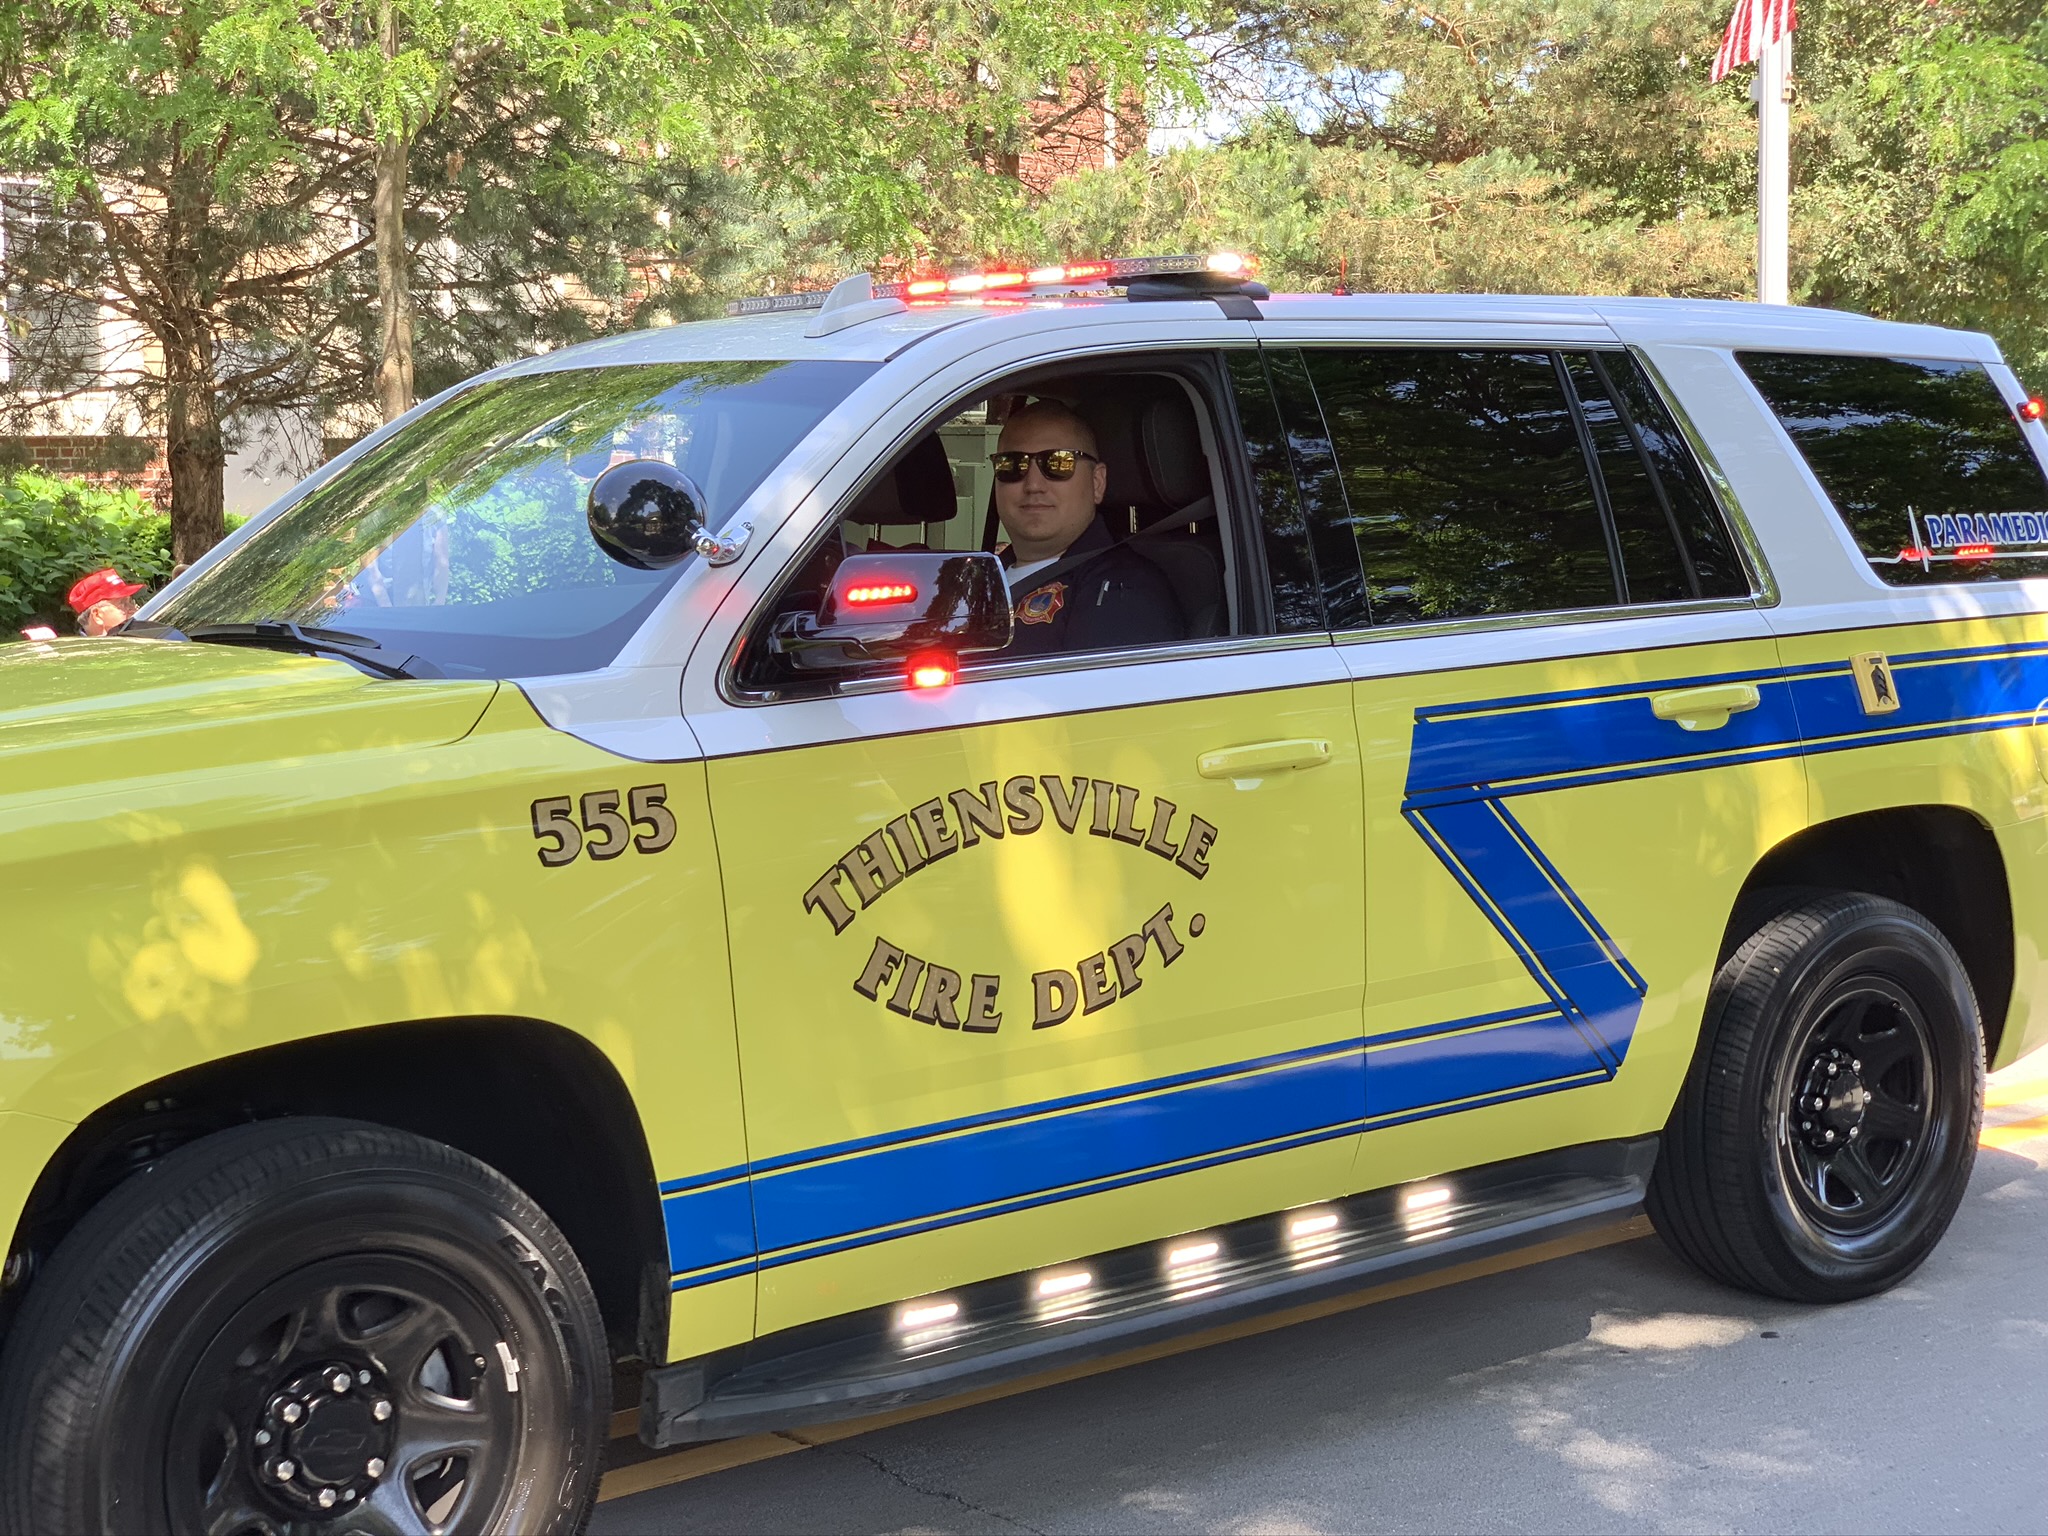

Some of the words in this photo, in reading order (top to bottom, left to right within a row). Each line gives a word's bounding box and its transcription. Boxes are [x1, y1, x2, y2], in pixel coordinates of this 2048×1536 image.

[1924, 511, 2048, 547] PARAMEDI
[530, 783, 677, 867] 555
[803, 775, 1218, 936] THIENSVILLE
[853, 936, 1002, 1033] FIRE
[1031, 902, 1206, 1030] DEPT.
